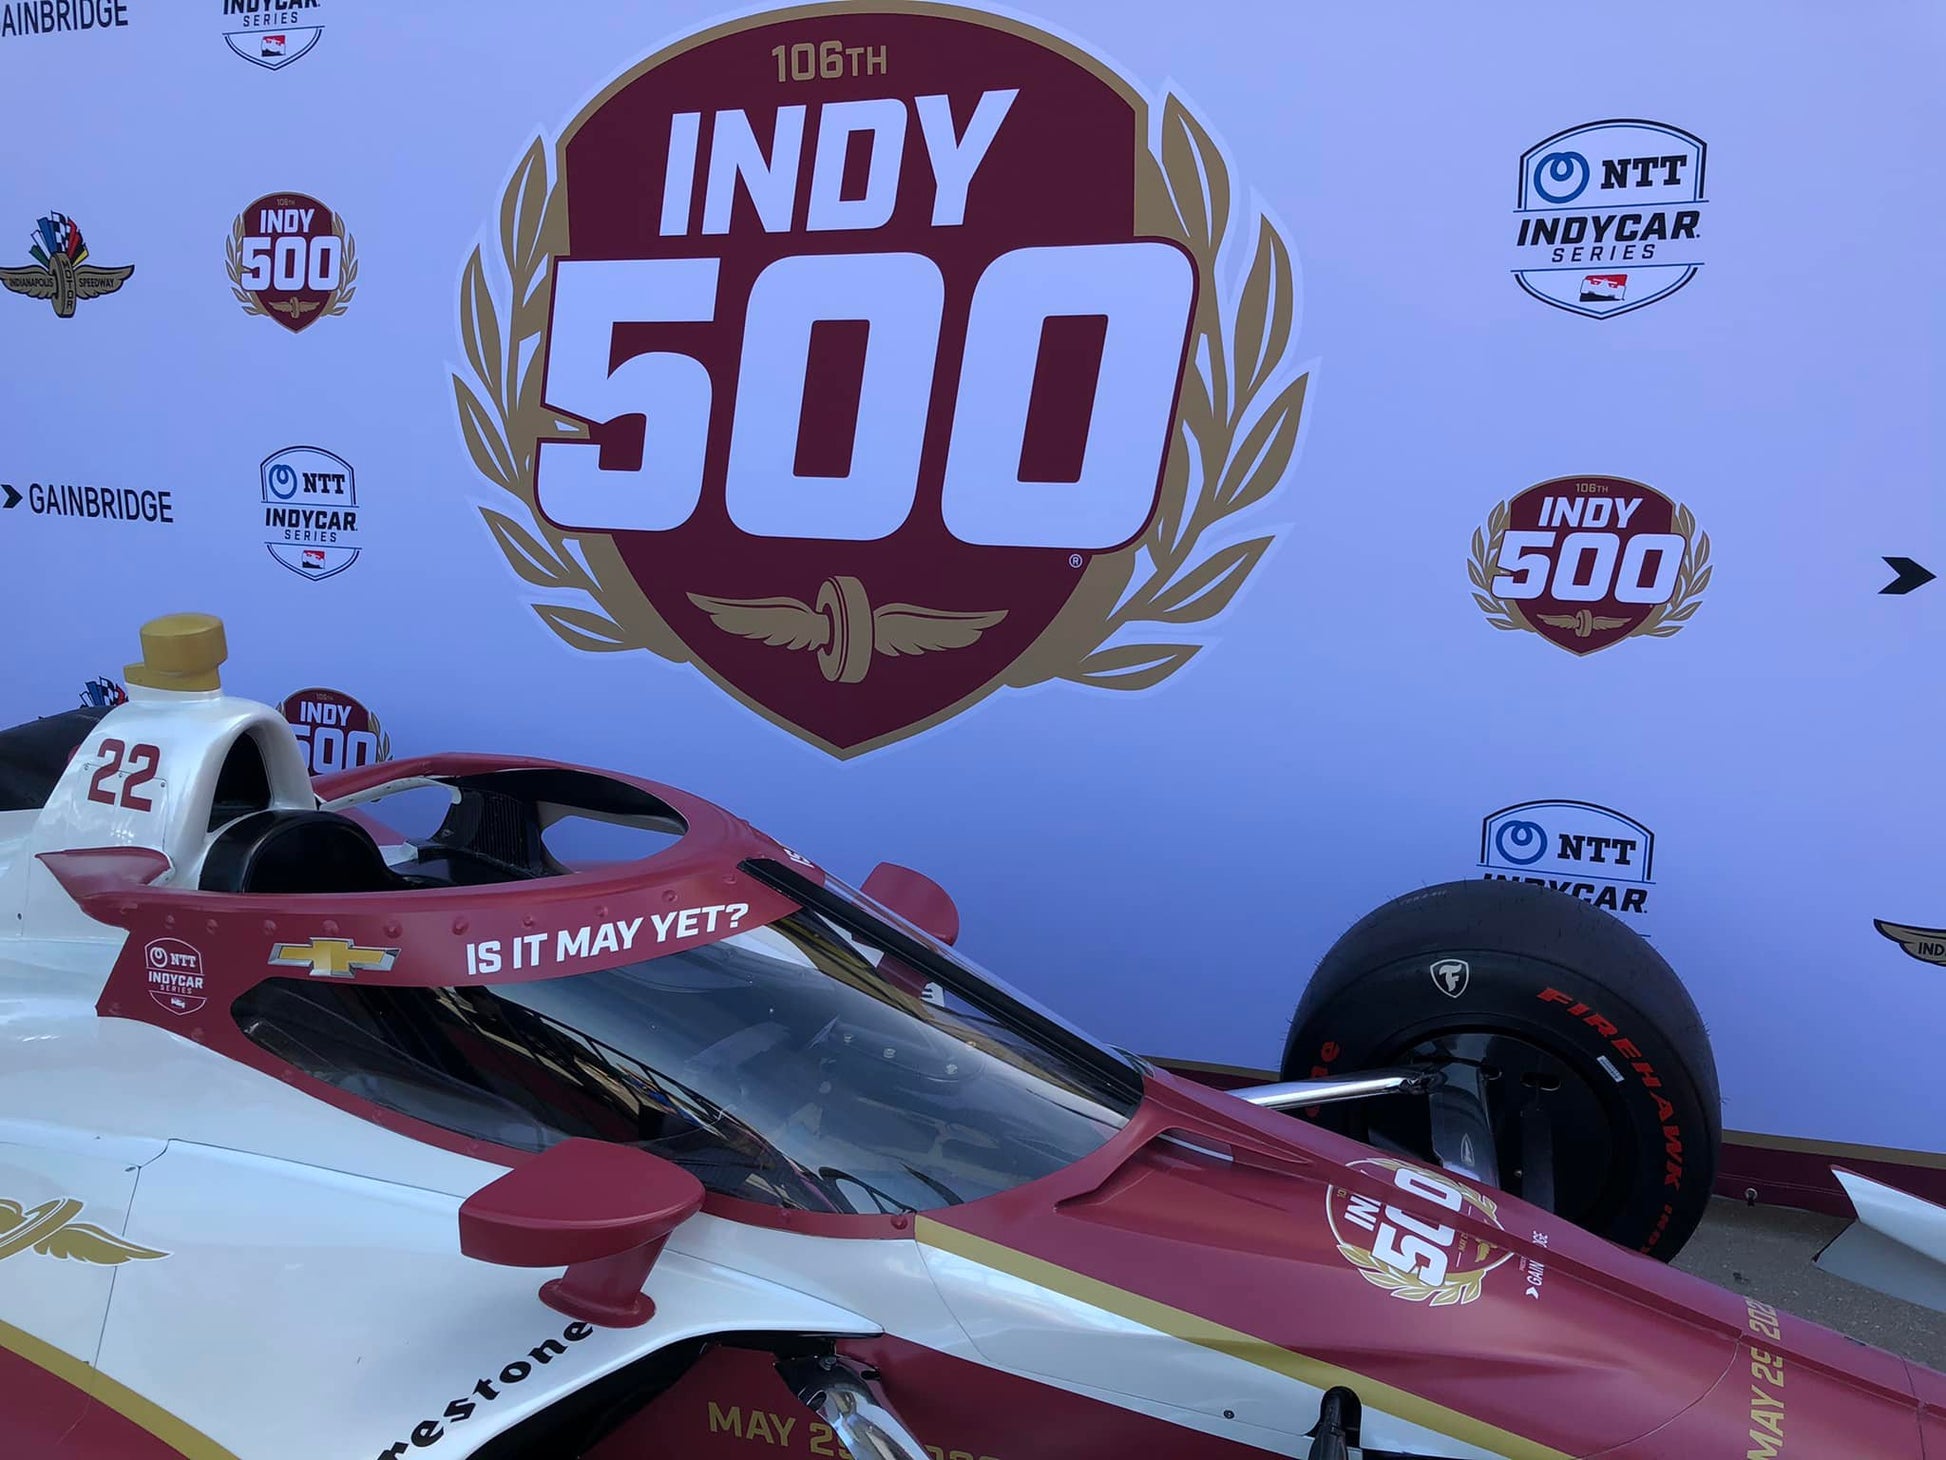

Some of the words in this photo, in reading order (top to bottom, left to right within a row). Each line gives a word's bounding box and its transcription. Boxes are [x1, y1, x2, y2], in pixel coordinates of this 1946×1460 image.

[243, 12, 298, 27] SERIES
[771, 40, 890, 83] 106TH
[658, 88, 1021, 237] INDY
[1601, 155, 1687, 189] NTT
[260, 208, 315, 234] INDY
[1517, 211, 1700, 246] INDYCAR
[241, 236, 342, 291] 500
[1552, 244, 1655, 262] SERIES
[535, 242, 1196, 550] 500
[302, 472, 345, 494] NTT
[1575, 483, 1609, 493] 106TH
[29, 483, 174, 523] GAINBRIDGE
[265, 507, 358, 531] INDYCAR
[1538, 497, 1643, 528] INDY
[284, 529, 337, 543] SERIES
[1491, 531, 1687, 604] 500
[300, 701, 352, 726] INDY
[87, 737, 160, 812] 22
[1557, 833, 1637, 866] NTT
[466, 941, 501, 975] IS
[513, 933, 547, 969] IT
[556, 917, 644, 962] MAY
[650, 903, 749, 943] YET?
[169, 952, 196, 968] NTT
[148, 971, 204, 989] INDYCAR
[160, 984, 193, 995] SERIES
[1536, 986, 1682, 1192] FIREHAWK
[707, 1401, 796, 1447] MAY
